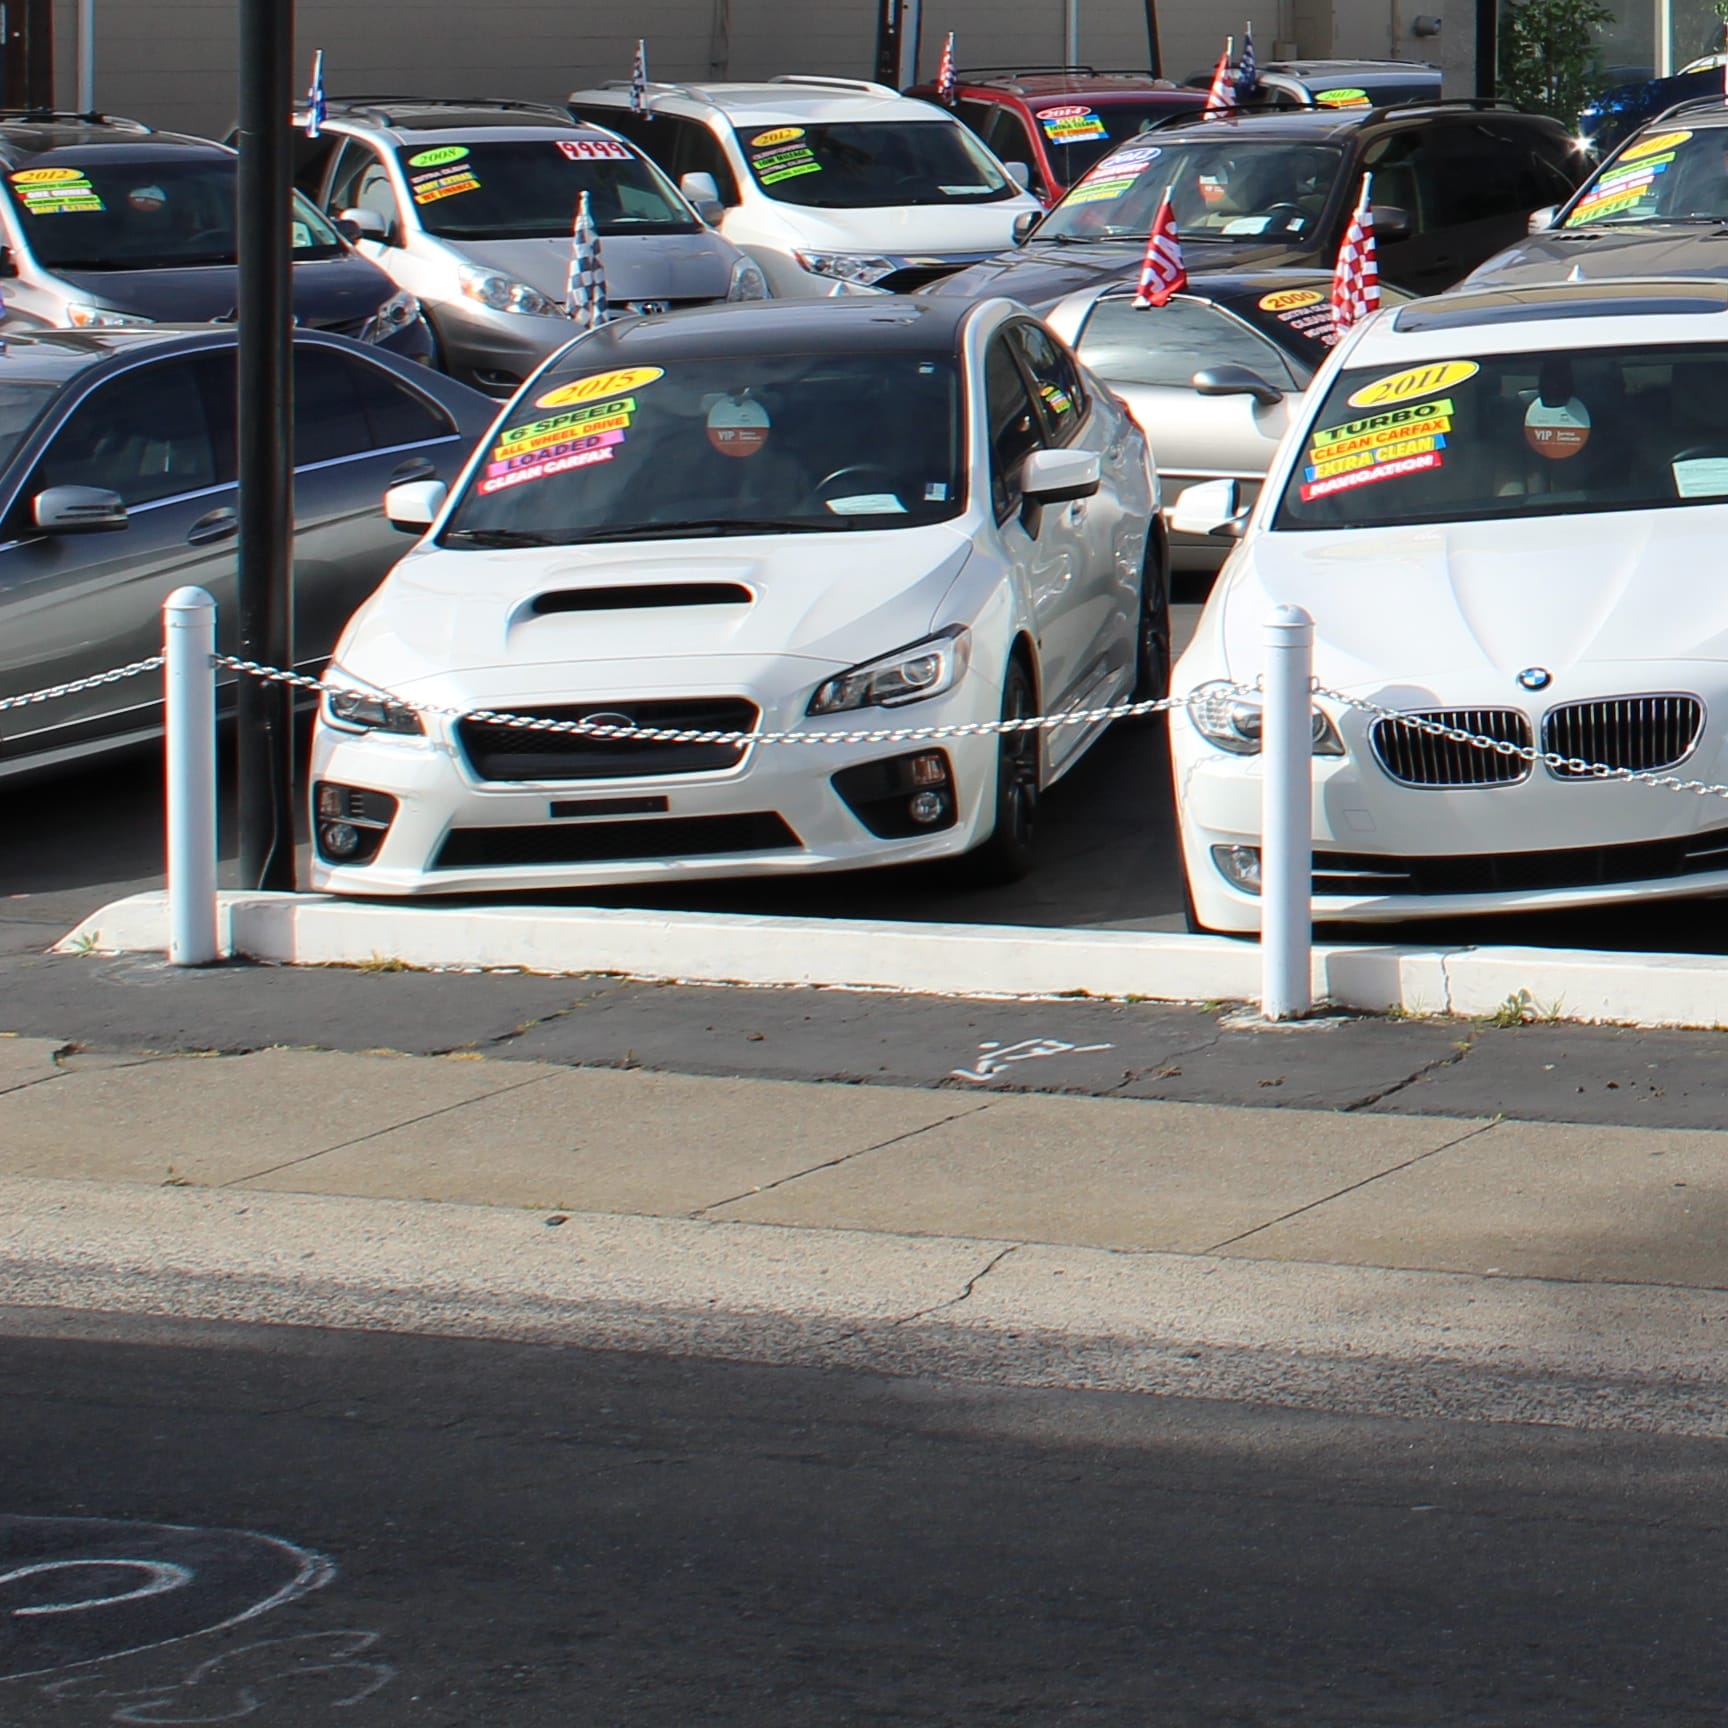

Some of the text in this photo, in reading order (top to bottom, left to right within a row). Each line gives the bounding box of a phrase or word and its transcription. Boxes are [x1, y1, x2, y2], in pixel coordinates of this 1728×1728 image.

[562, 141, 629, 159] 9999
[1267, 291, 1317, 309] 2000
[553, 370, 636, 404] 2015
[1370, 364, 1449, 404] 2011
[499, 416, 625, 457] ALL WHEEL DRIVE
[509, 400, 628, 441] 6 SPEED
[717, 431, 735, 441] VIP
[1314, 419, 1445, 460] CLEAN CARFAX
[1325, 404, 1438, 440] TURBO
[1534, 429, 1552, 441] VIP
[483, 447, 613, 492] CLEAN CARFAX
[506, 435, 601, 470] LOADED
[1315, 436, 1435, 479] EXTRA CLEAN
[1309, 455, 1435, 497] NAVIGATION
